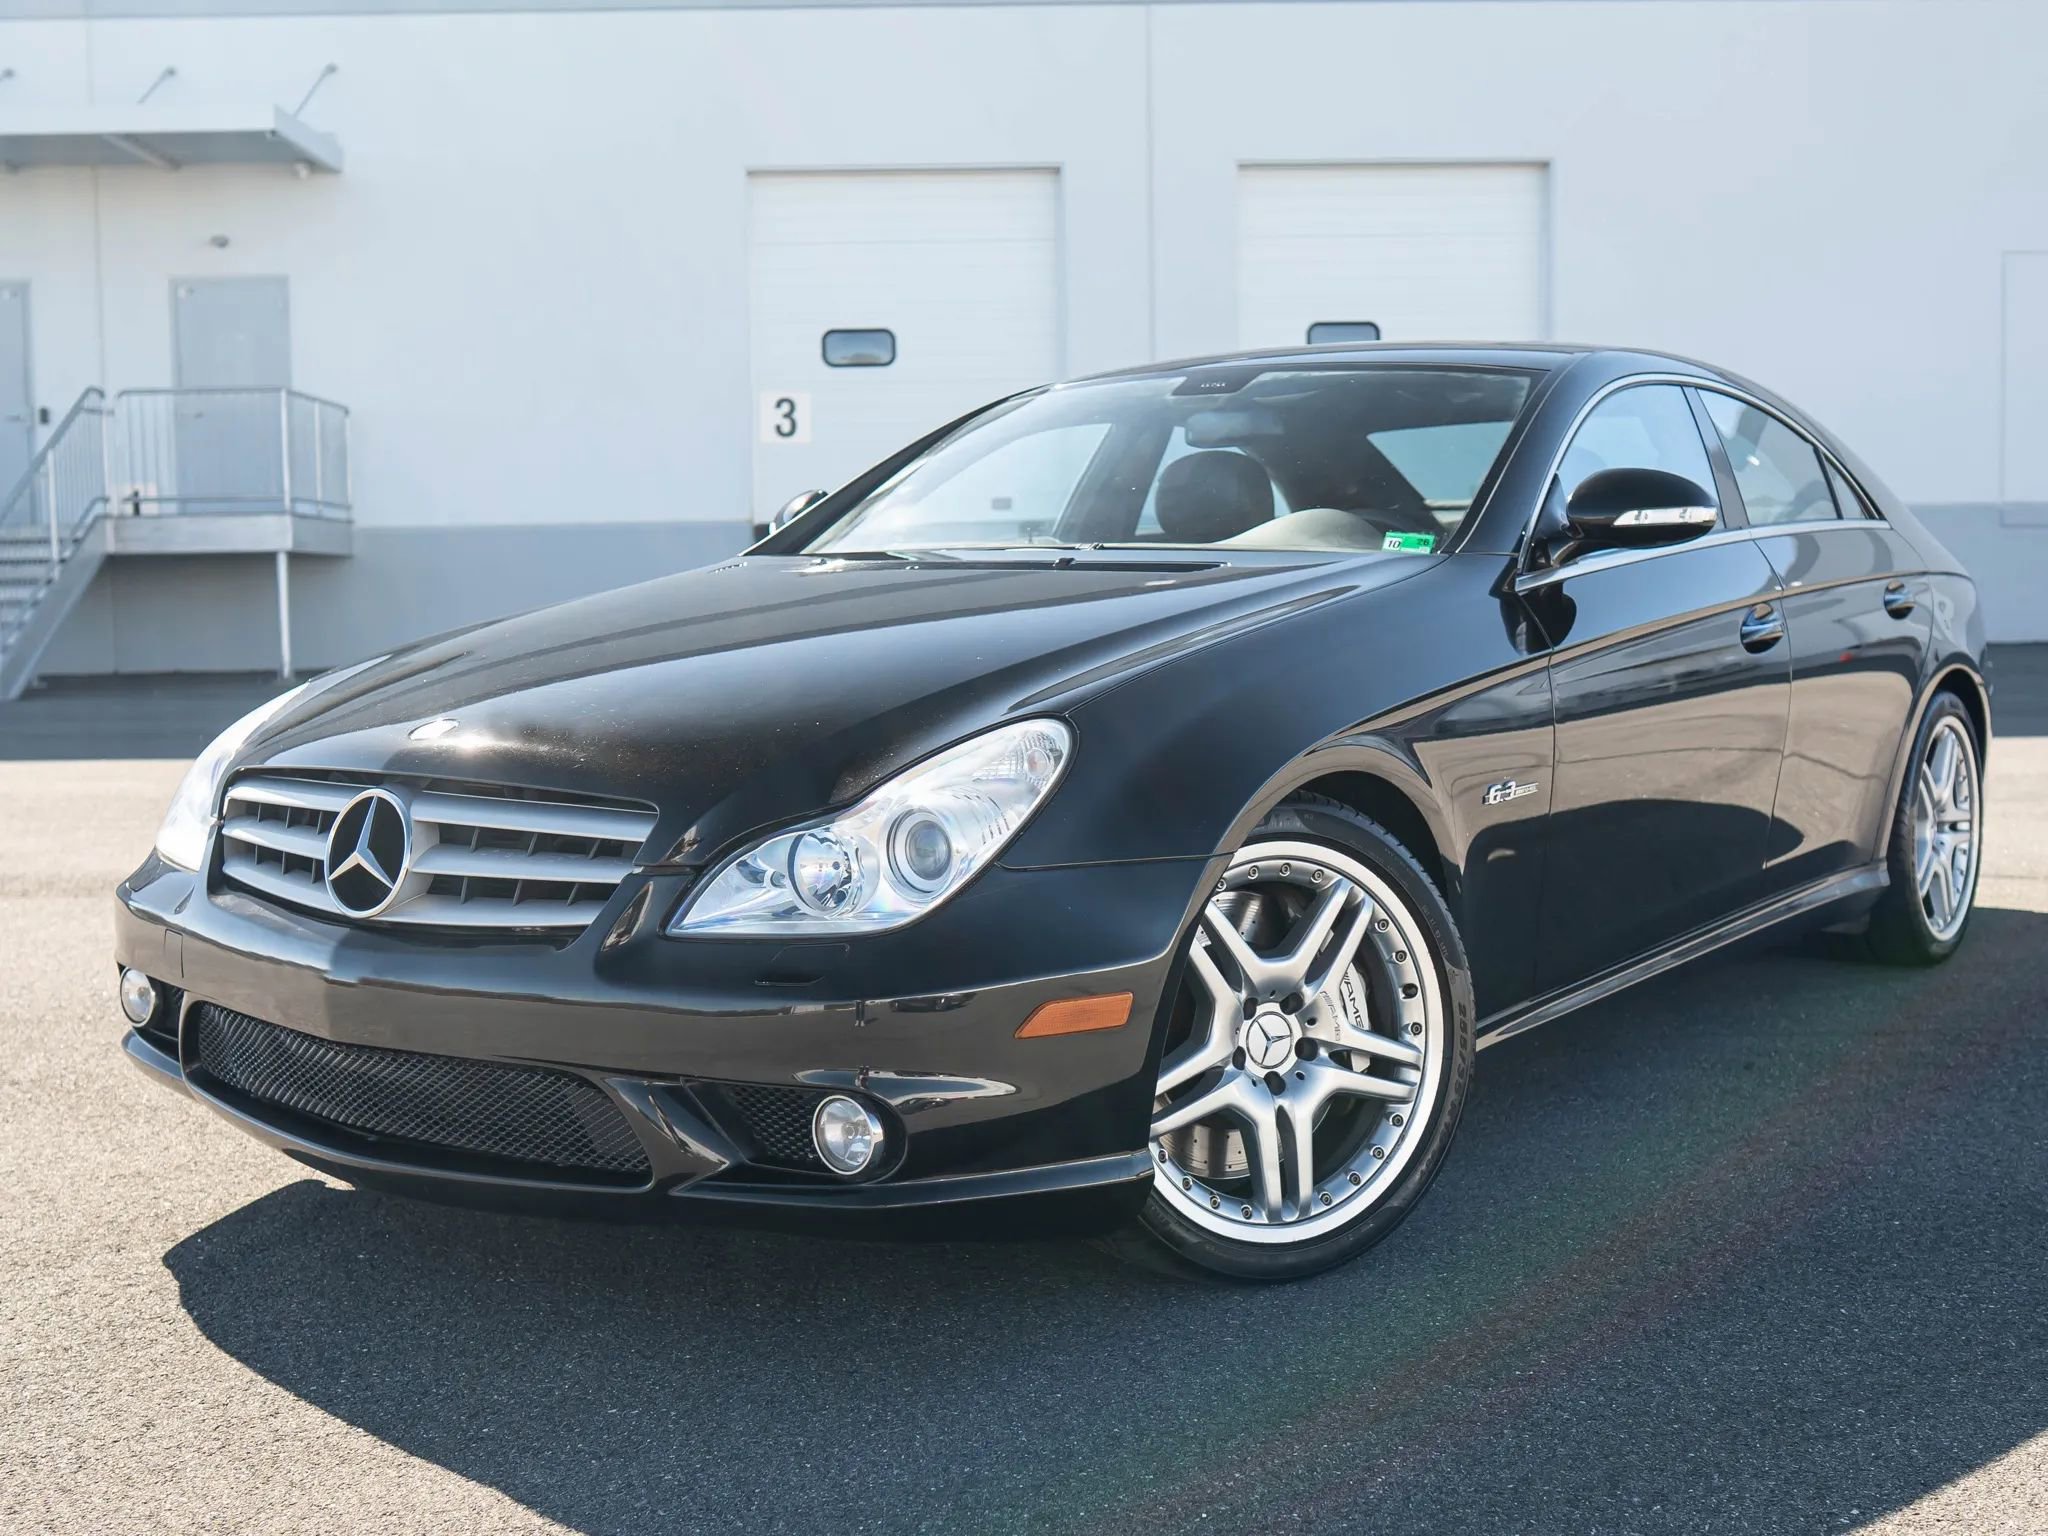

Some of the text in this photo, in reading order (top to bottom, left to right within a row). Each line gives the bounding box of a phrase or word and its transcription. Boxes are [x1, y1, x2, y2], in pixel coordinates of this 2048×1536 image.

[775, 397, 797, 438] 3
[1388, 539, 1402, 549] 10
[1343, 980, 1365, 1029] AMG
